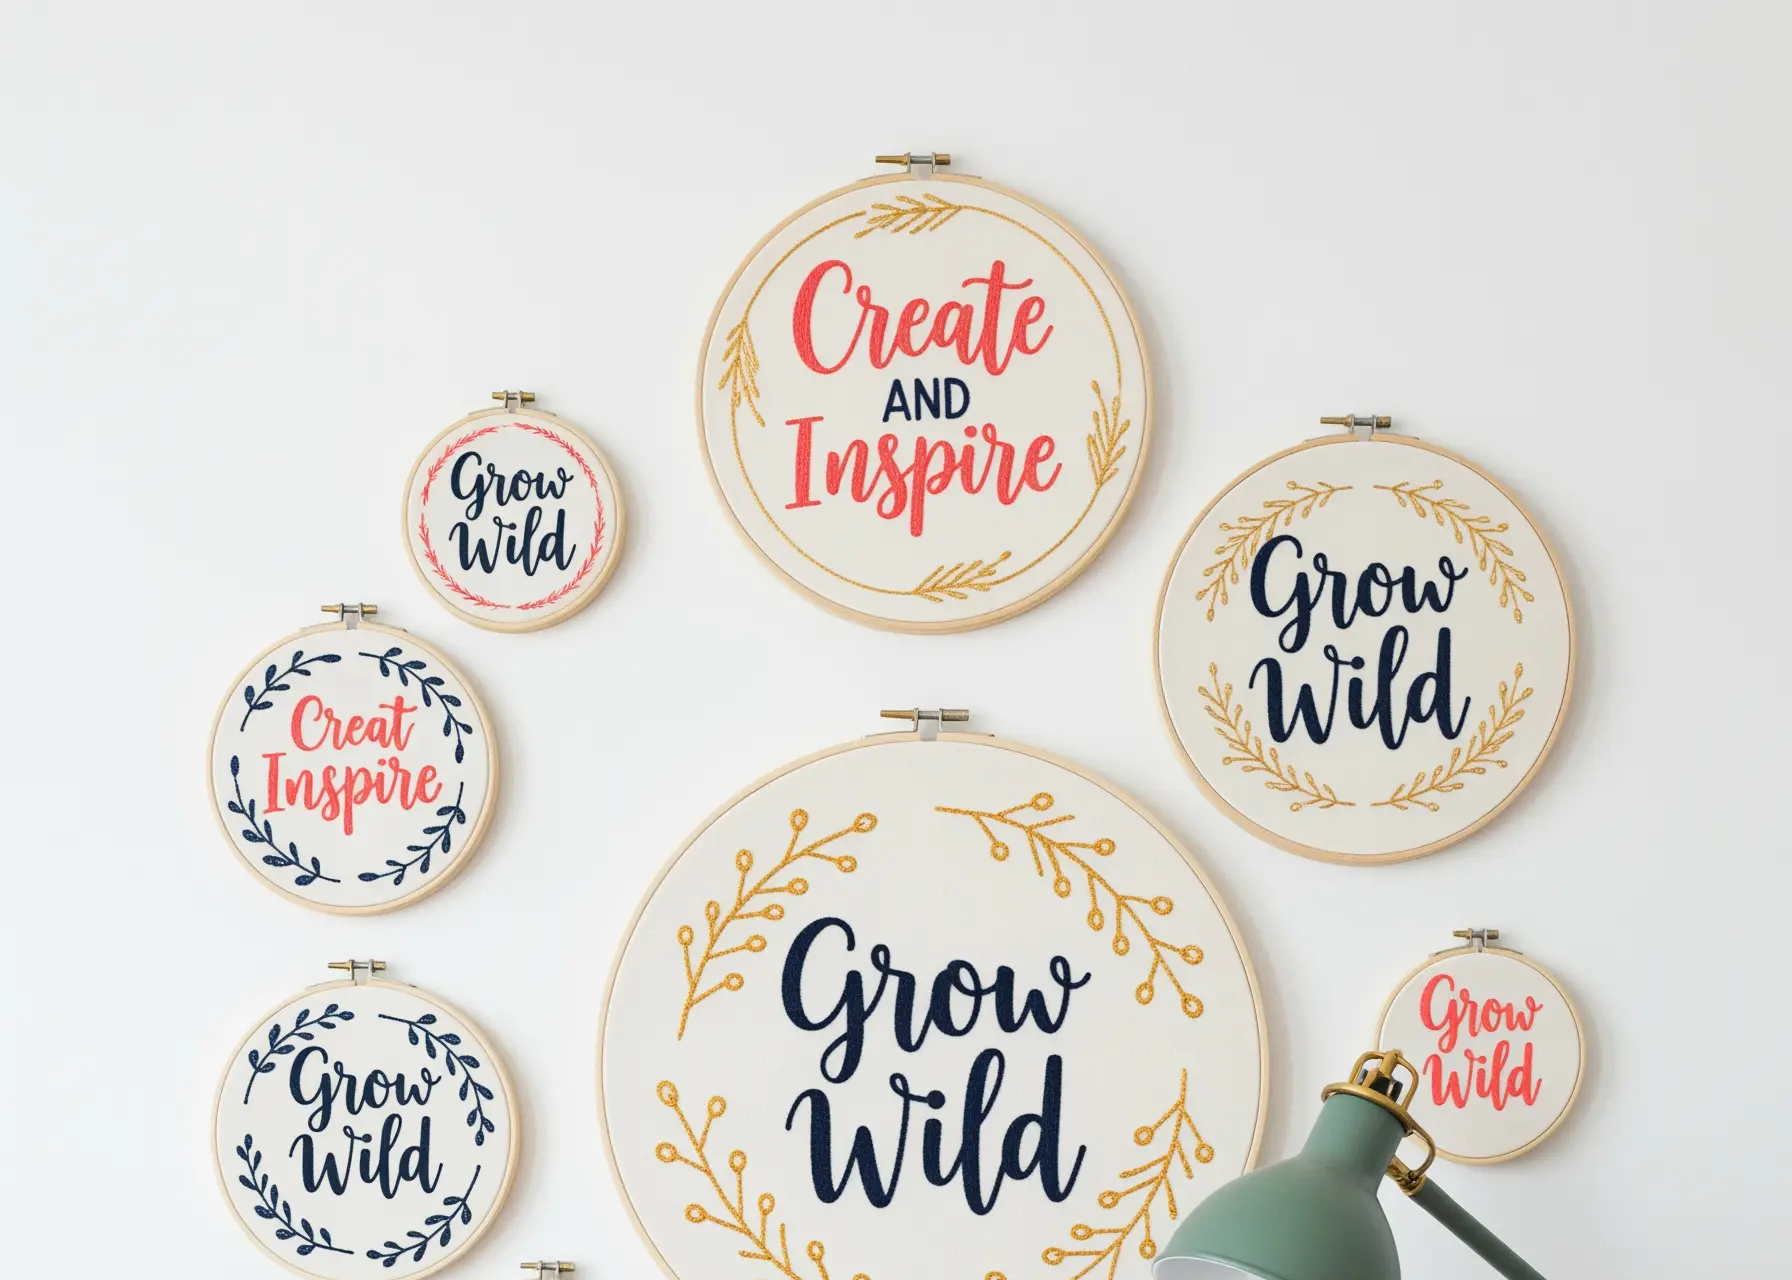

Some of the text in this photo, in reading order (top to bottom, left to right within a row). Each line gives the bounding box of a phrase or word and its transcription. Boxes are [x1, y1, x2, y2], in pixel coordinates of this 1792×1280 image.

[791, 259, 1054, 377] Create
[881, 377, 971, 423] AND
[450, 451, 574, 521] Grow
[784, 415, 1063, 538] Inspire
[448, 506, 577, 577] Wild
[1249, 534, 1469, 654] Grow
[290, 695, 418, 752] Creat
[1248, 624, 1472, 751] Wild
[261, 751, 443, 836] Inspire
[781, 916, 1092, 1085] Grow
[1419, 972, 1544, 1054] Grow
[289, 1045, 442, 1133] Grow
[1422, 1040, 1543, 1112] Wild
[288, 1112, 443, 1200] Wild
[784, 1047, 1087, 1216] Wild
